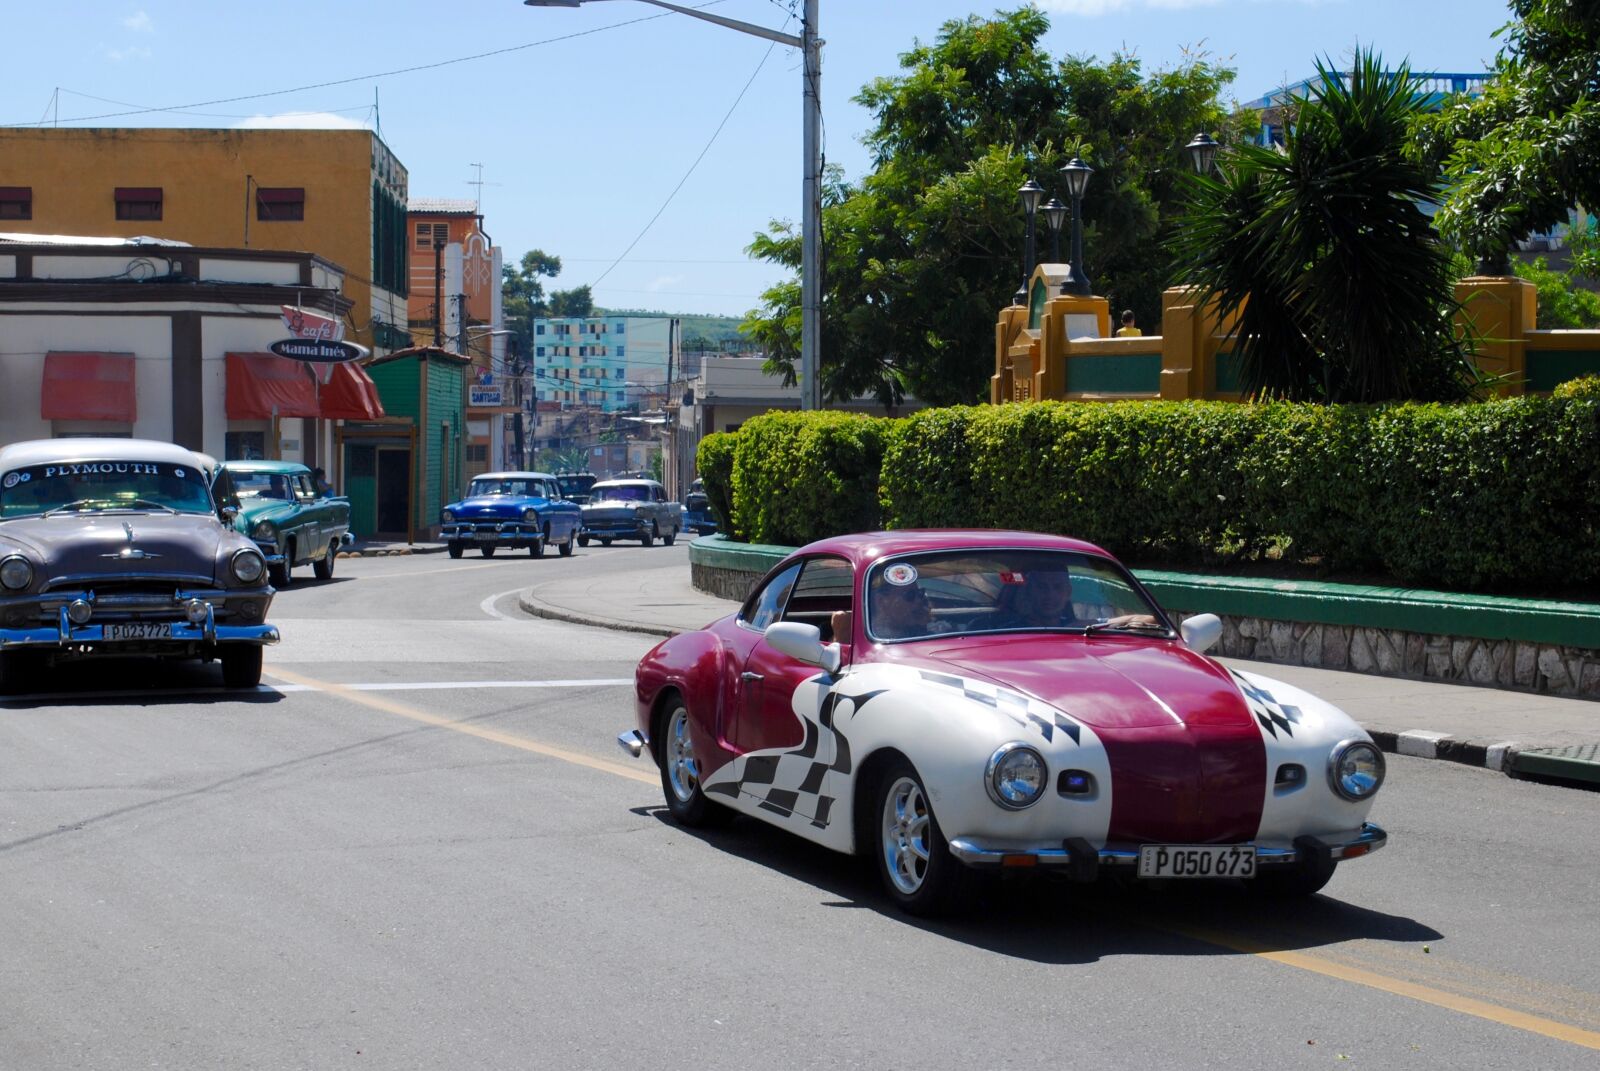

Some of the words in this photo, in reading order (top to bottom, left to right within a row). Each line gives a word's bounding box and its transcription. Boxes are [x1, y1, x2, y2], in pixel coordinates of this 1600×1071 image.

[302, 321, 331, 344] café
[281, 343, 318, 356] Mama
[320, 344, 346, 358] Inés
[45, 463, 159, 478] PLYMOUTH
